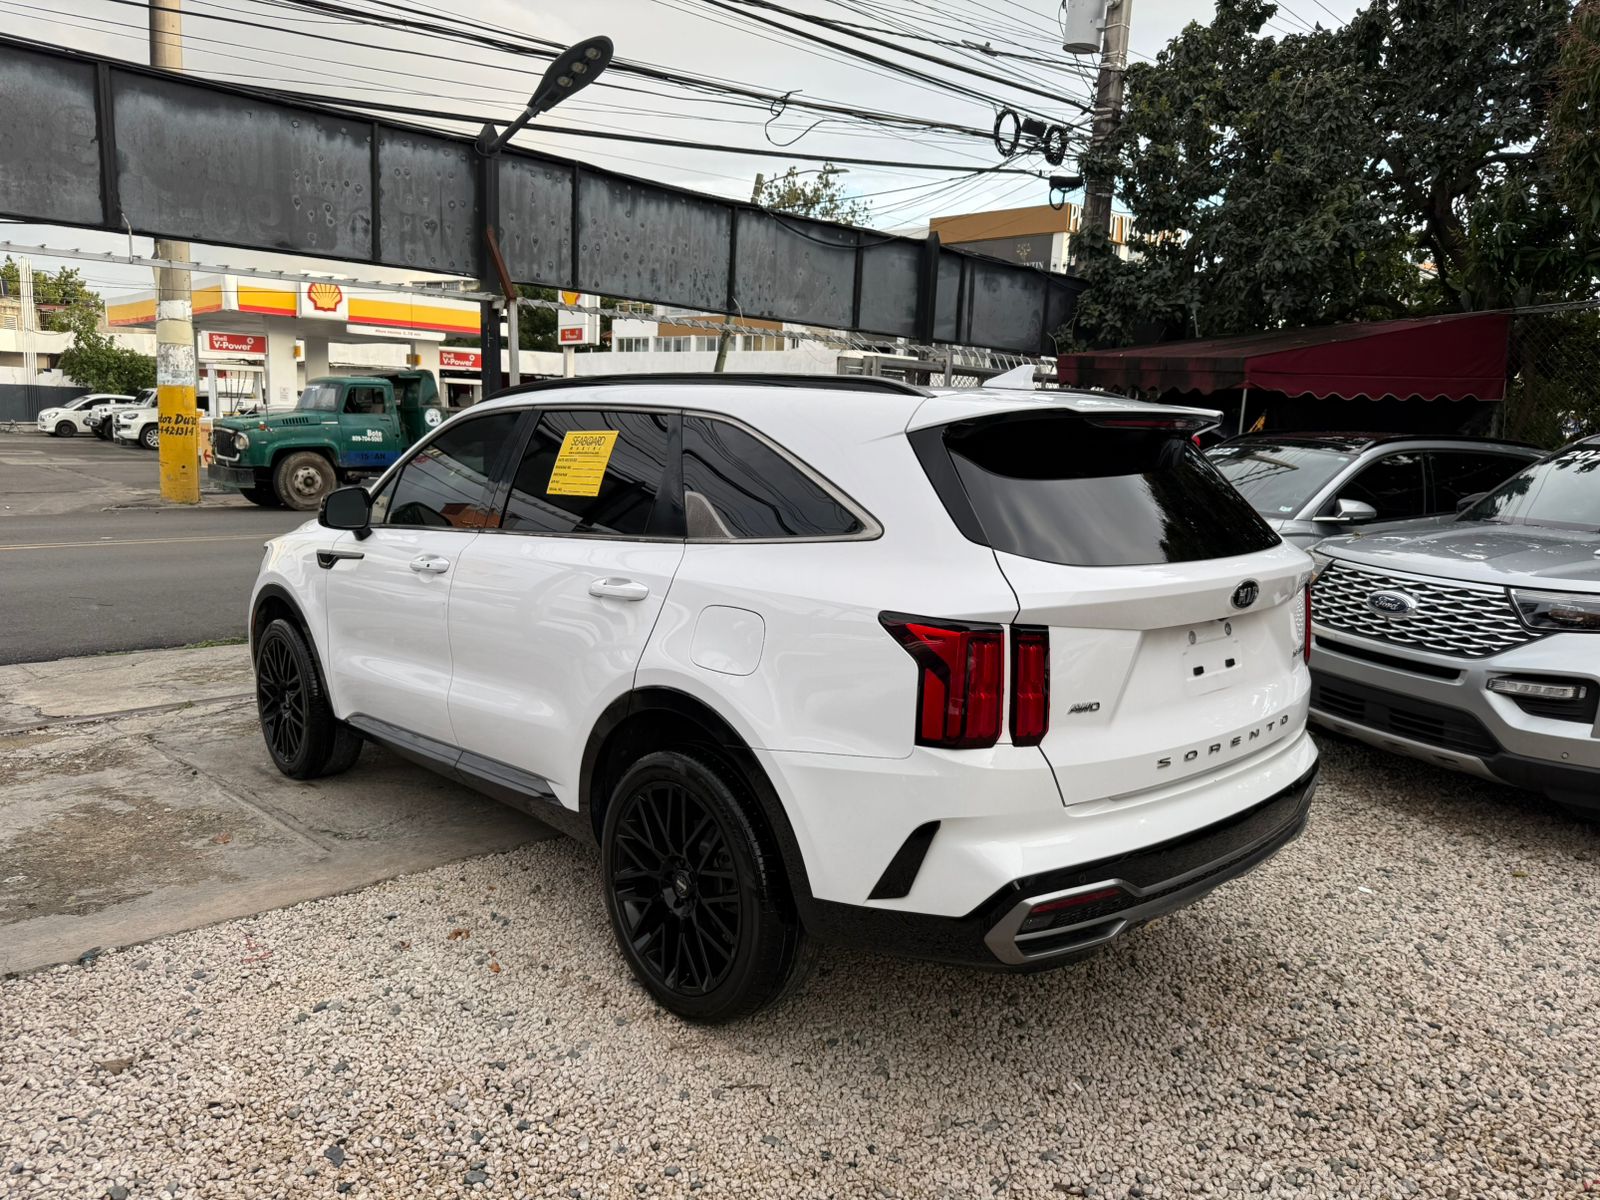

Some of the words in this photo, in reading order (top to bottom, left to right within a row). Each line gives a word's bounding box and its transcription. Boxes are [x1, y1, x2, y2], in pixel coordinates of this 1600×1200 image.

[213, 341, 252, 351] V-Power
[443, 358, 473, 366] V-Power
[1374, 595, 1401, 610] Ford
[1067, 701, 1100, 715] AWD
[1156, 714, 1289, 769] SORENTO
